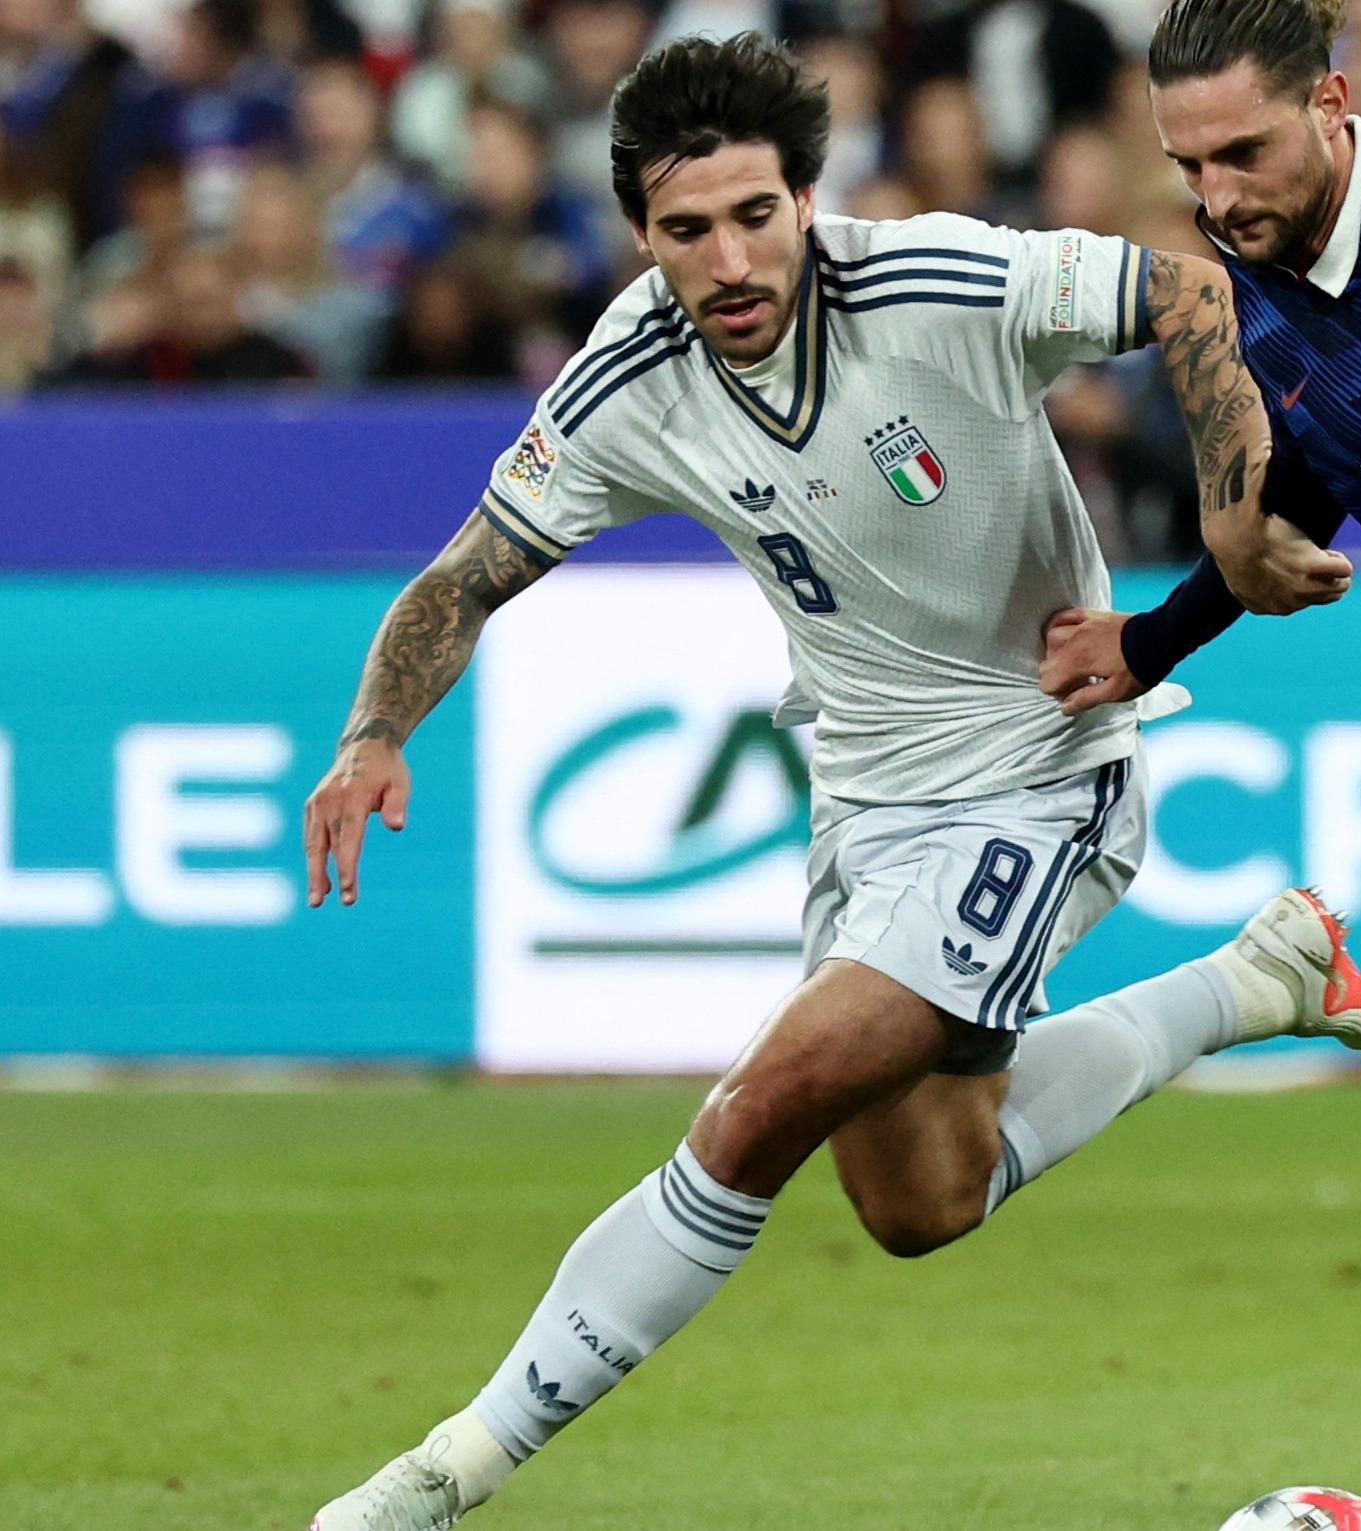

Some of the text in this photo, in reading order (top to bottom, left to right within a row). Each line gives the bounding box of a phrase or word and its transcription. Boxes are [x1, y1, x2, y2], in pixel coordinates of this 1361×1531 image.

[1058, 235, 1073, 329] FOUNDATION
[876, 433, 921, 467] ITALIA
[757, 532, 841, 616] 8
[957, 837, 1036, 941] 8
[567, 1309, 636, 1377] ITALIA
